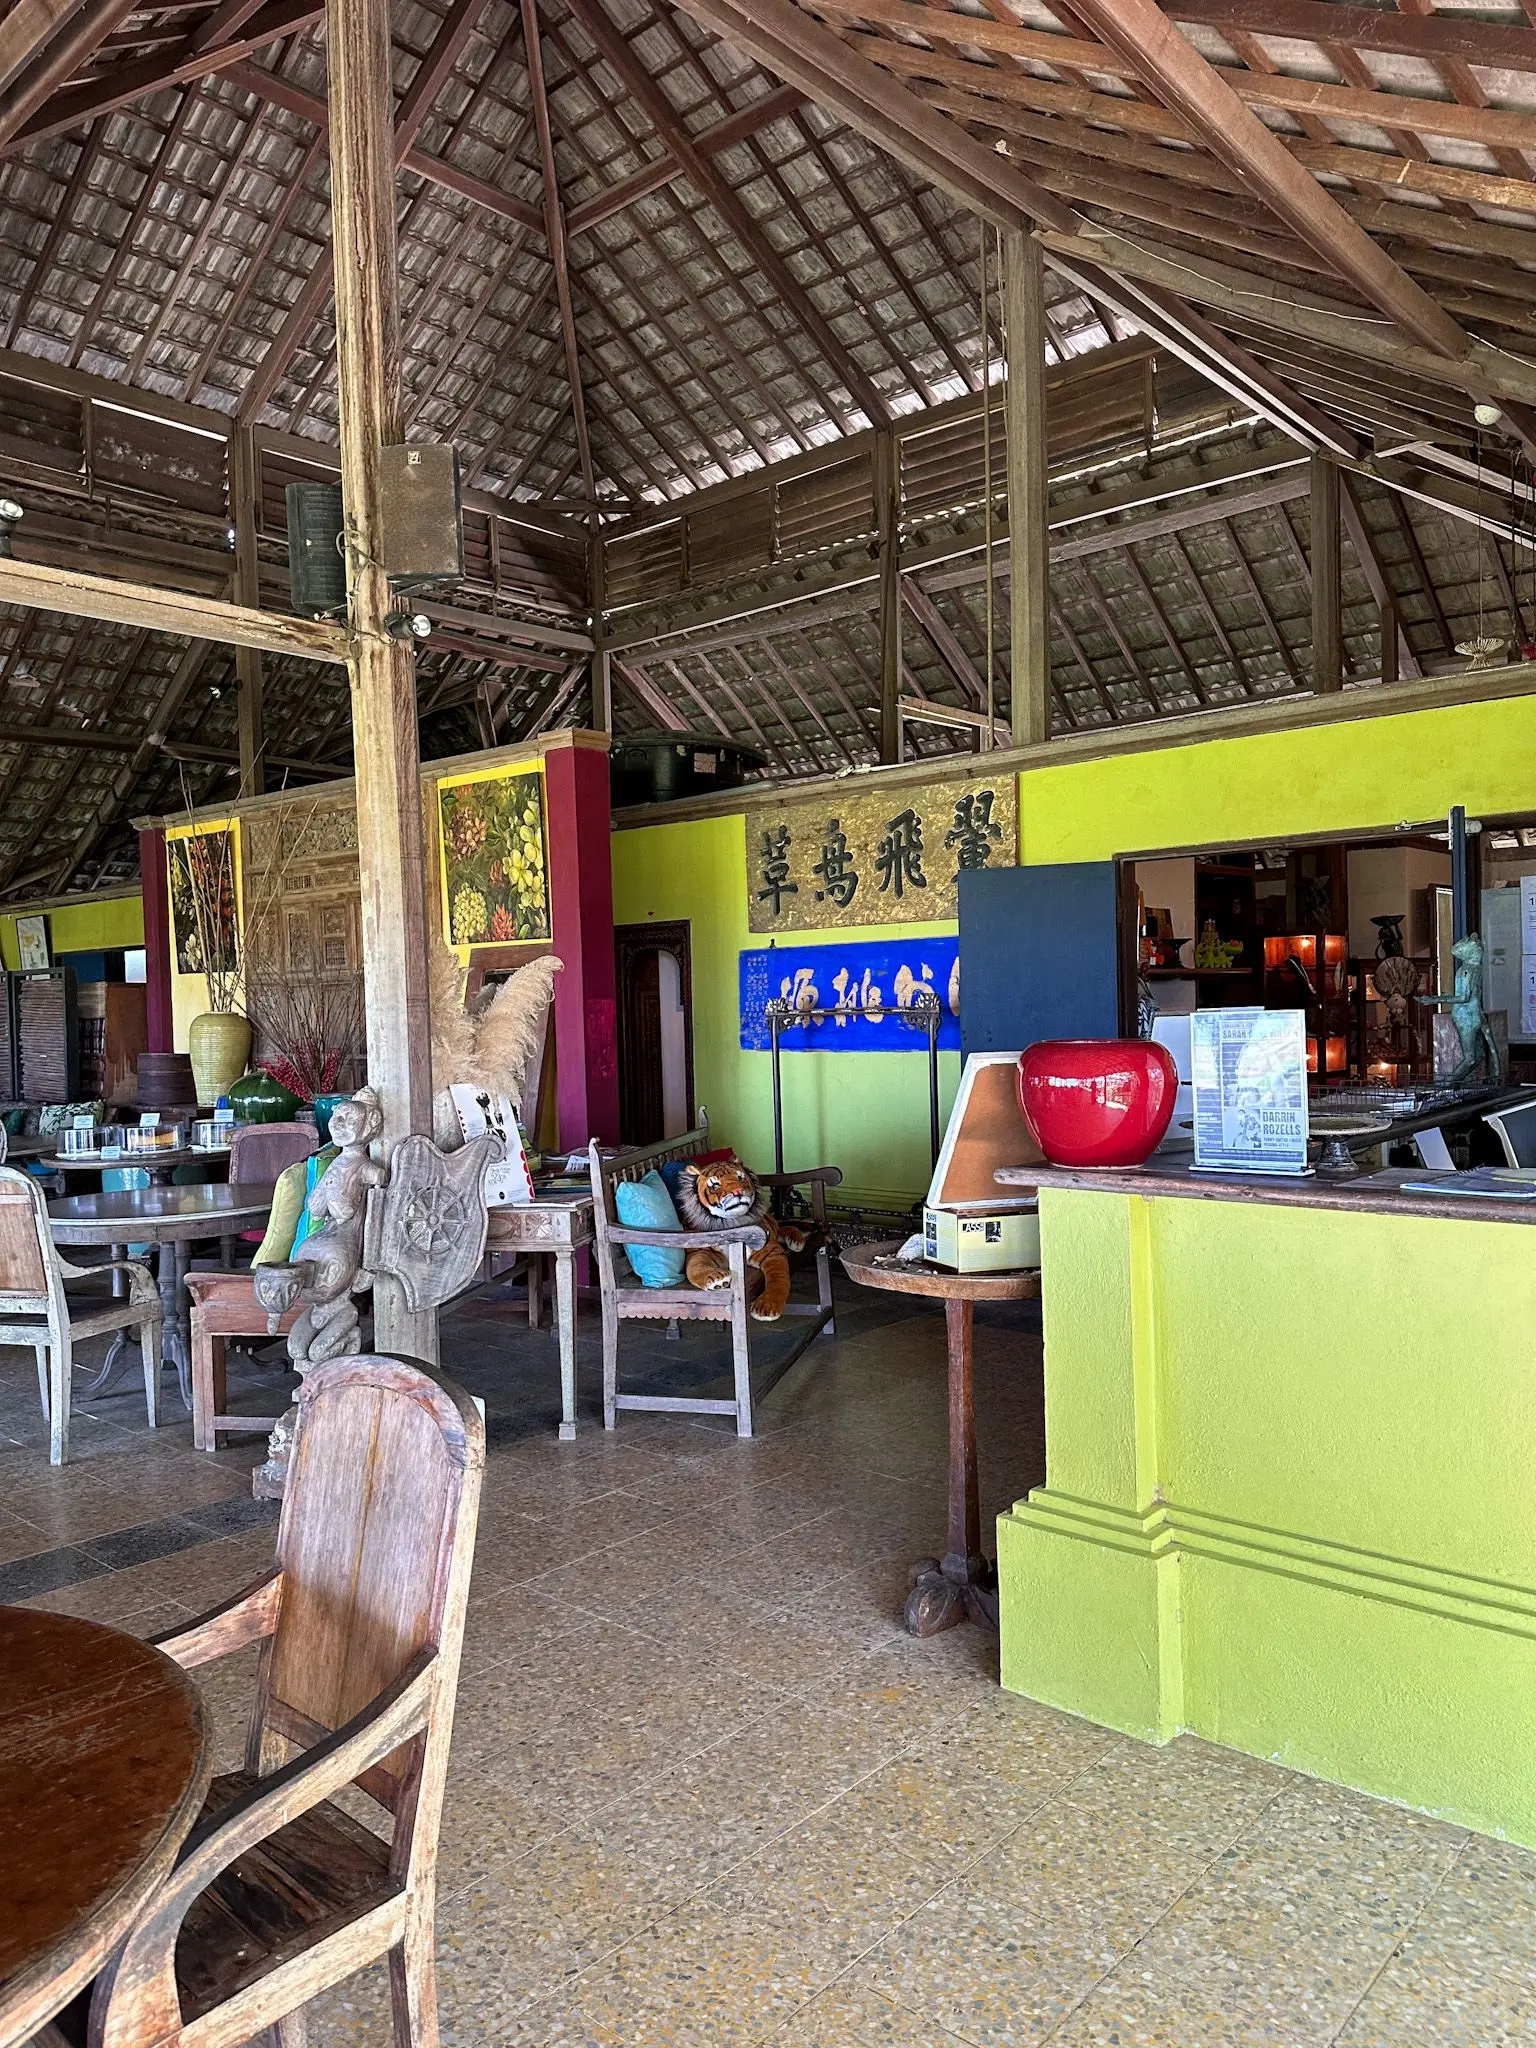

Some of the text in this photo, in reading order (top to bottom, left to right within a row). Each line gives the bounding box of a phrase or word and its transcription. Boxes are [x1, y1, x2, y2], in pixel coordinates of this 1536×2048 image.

[1222, 1029, 1247, 1039] SARAH
[1262, 1111, 1296, 1123] DARRIN
[1263, 1123, 1301, 1136] ROZELLS
